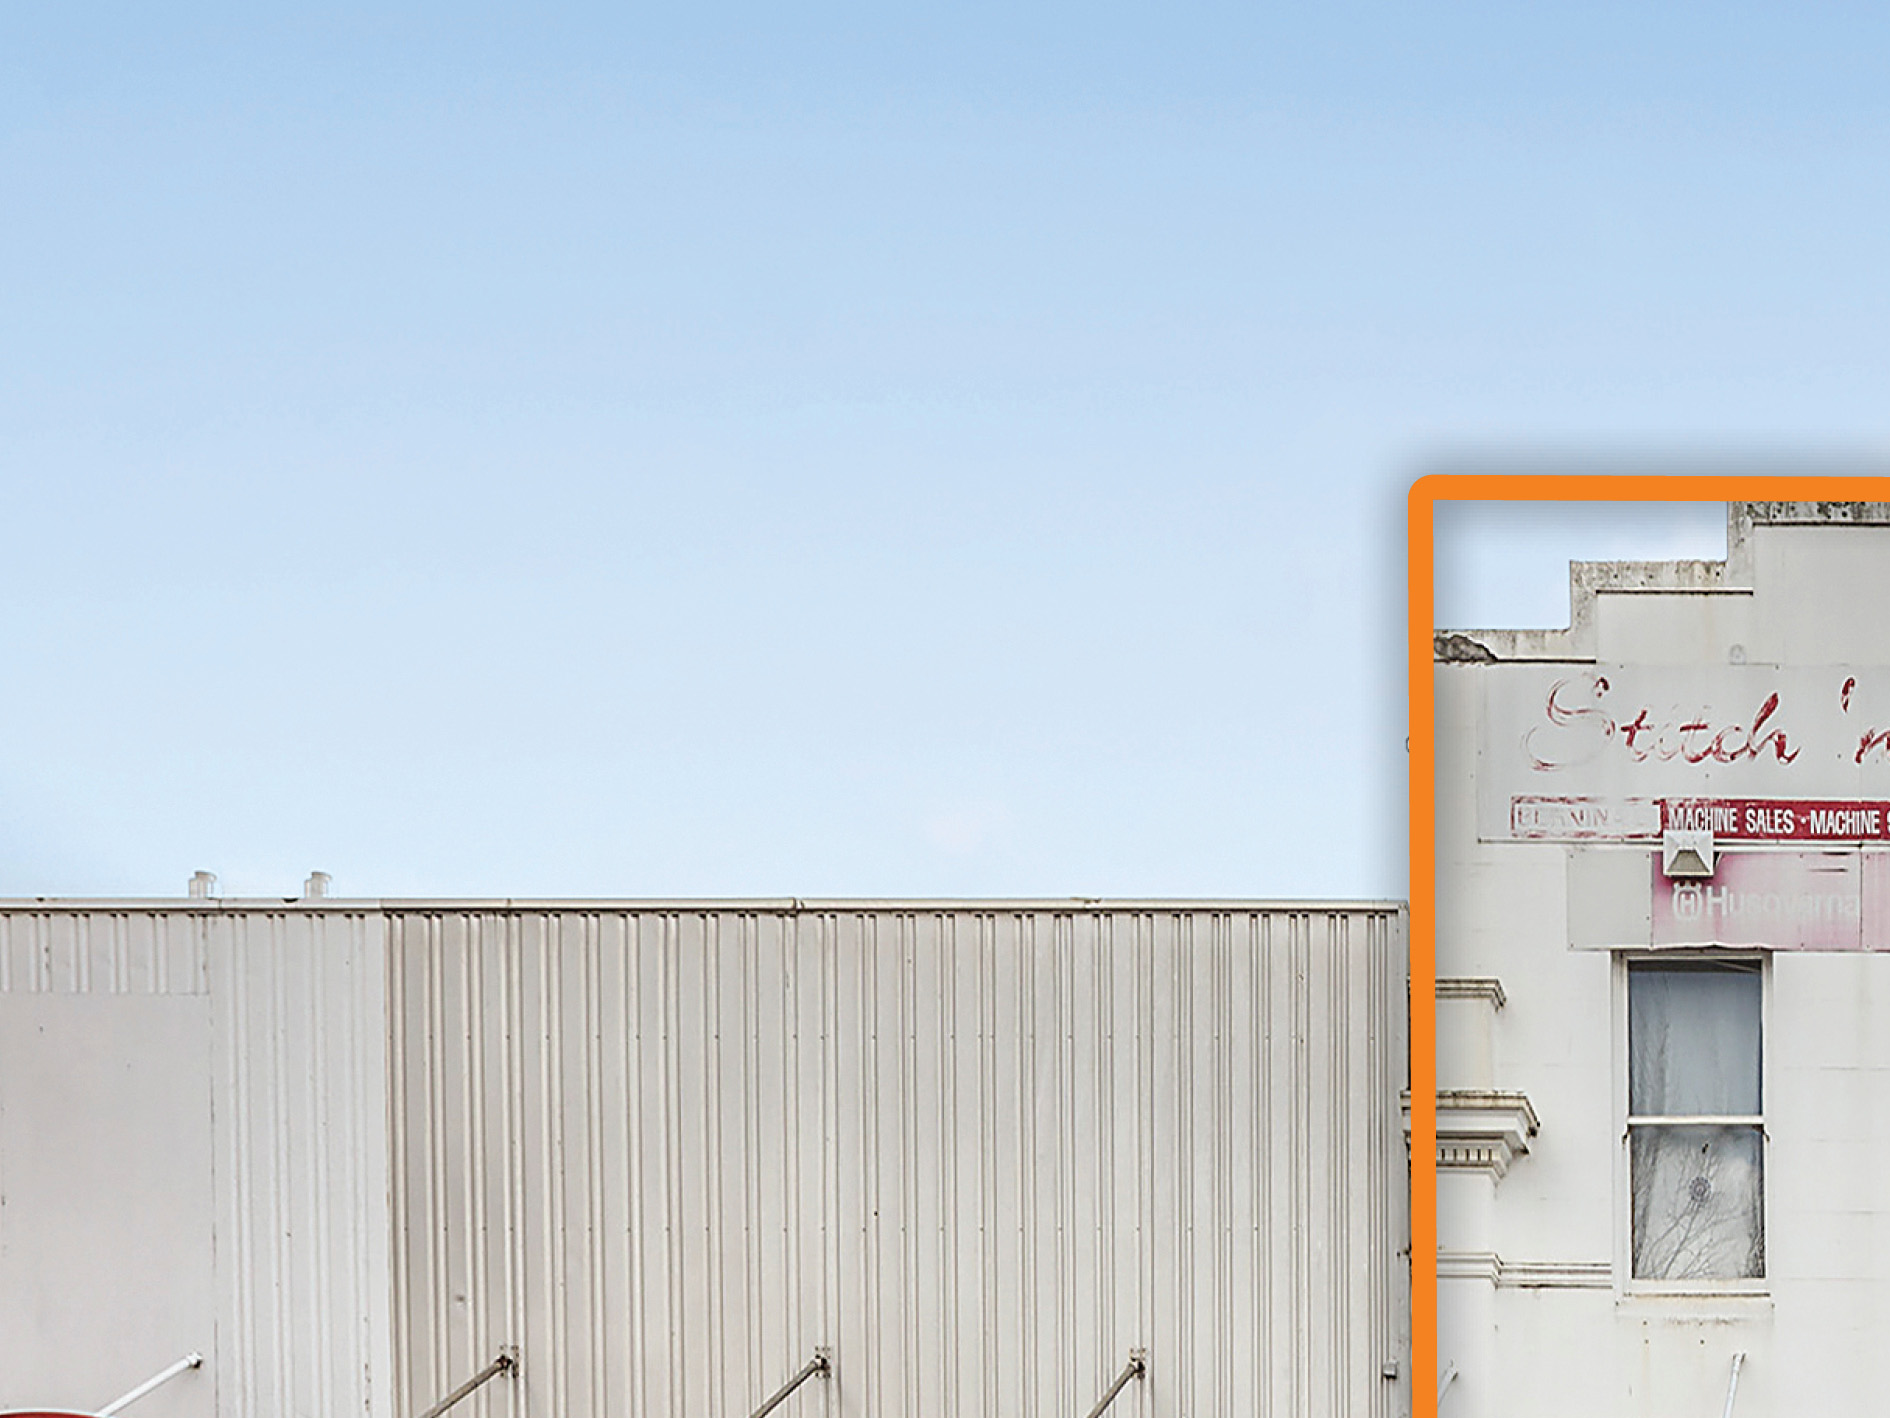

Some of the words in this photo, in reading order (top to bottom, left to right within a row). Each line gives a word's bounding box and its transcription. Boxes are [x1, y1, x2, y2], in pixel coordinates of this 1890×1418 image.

[1519, 676, 1801, 774] Stitch
[1668, 806, 1739, 834] MACHINE
[1745, 807, 1795, 835] SALES
[1810, 808, 1881, 835] MACHINE
